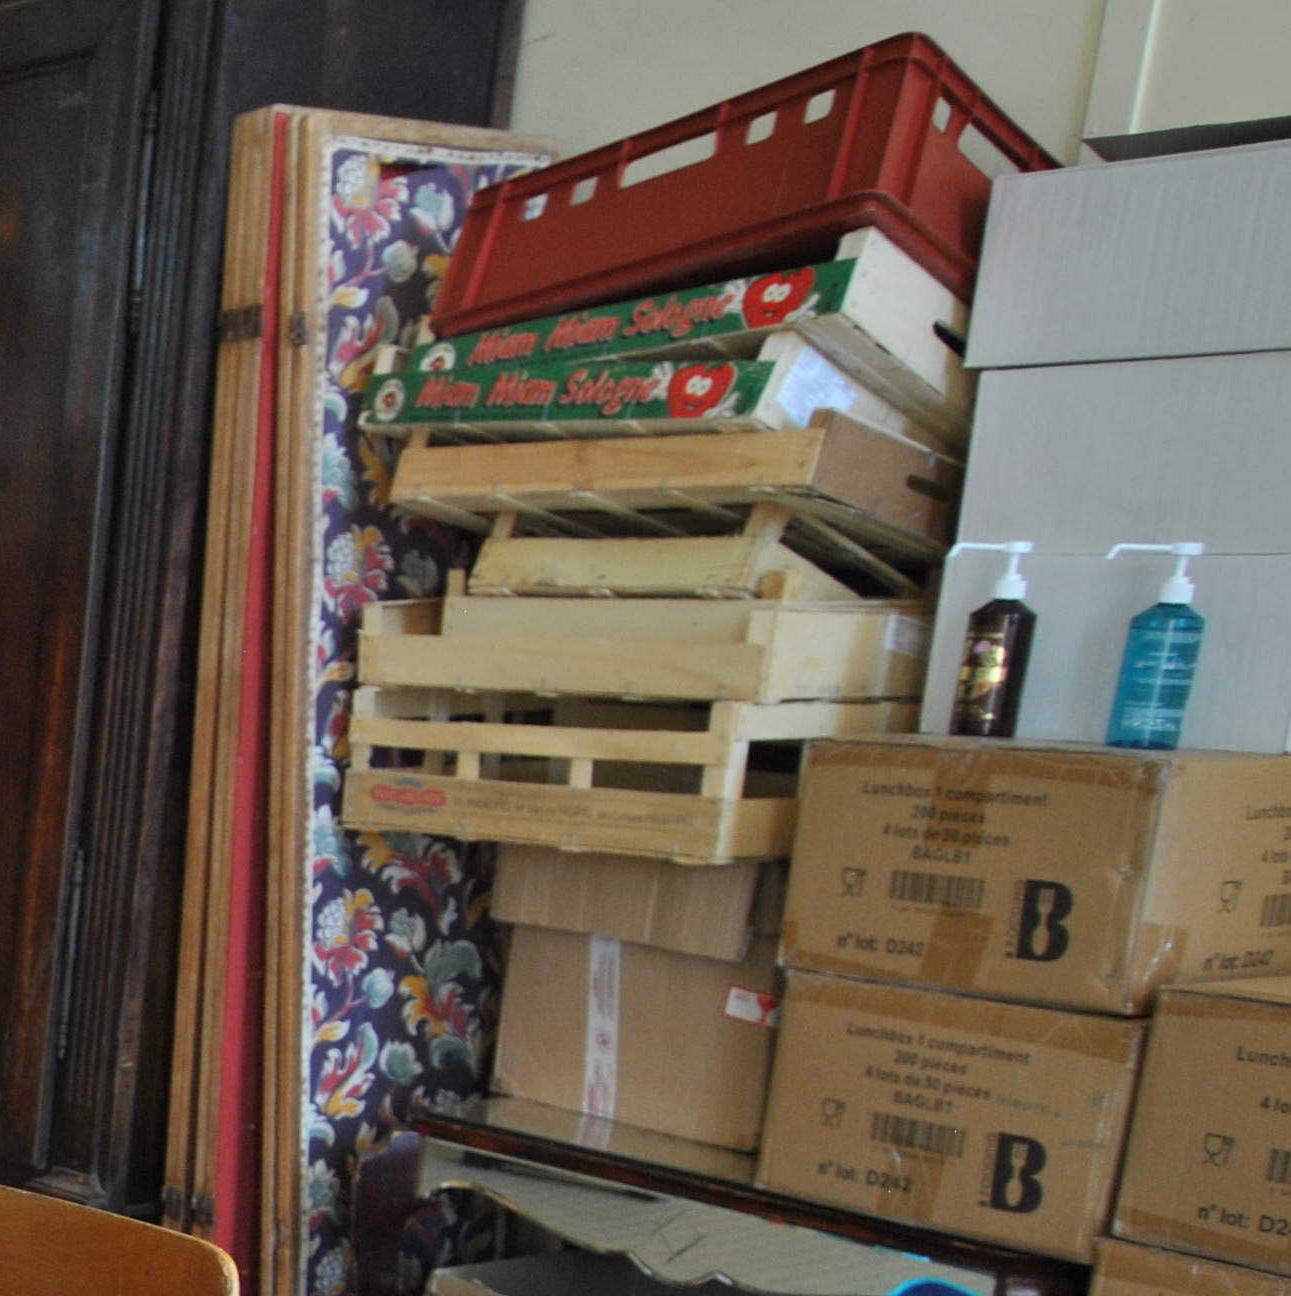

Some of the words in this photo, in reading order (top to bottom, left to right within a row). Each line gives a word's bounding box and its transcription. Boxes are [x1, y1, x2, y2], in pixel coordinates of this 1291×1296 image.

[467, 328, 539, 367] Miam
[545, 312, 620, 353] Miam
[624, 290, 735, 338] Sologne
[415, 373, 480, 409] Miam
[485, 373, 558, 408] Miam
[559, 367, 662, 416] Sologne
[862, 780, 932, 799] Lunchbox
[945, 786, 1048, 808] compartiment
[886, 938, 925, 958] D242
[846, 1021, 913, 1046] Lunchbox
[927, 1036, 1030, 1066] compartiment
[865, 1169, 914, 1195] D242
[1258, 1214, 1291, 1237] D2
